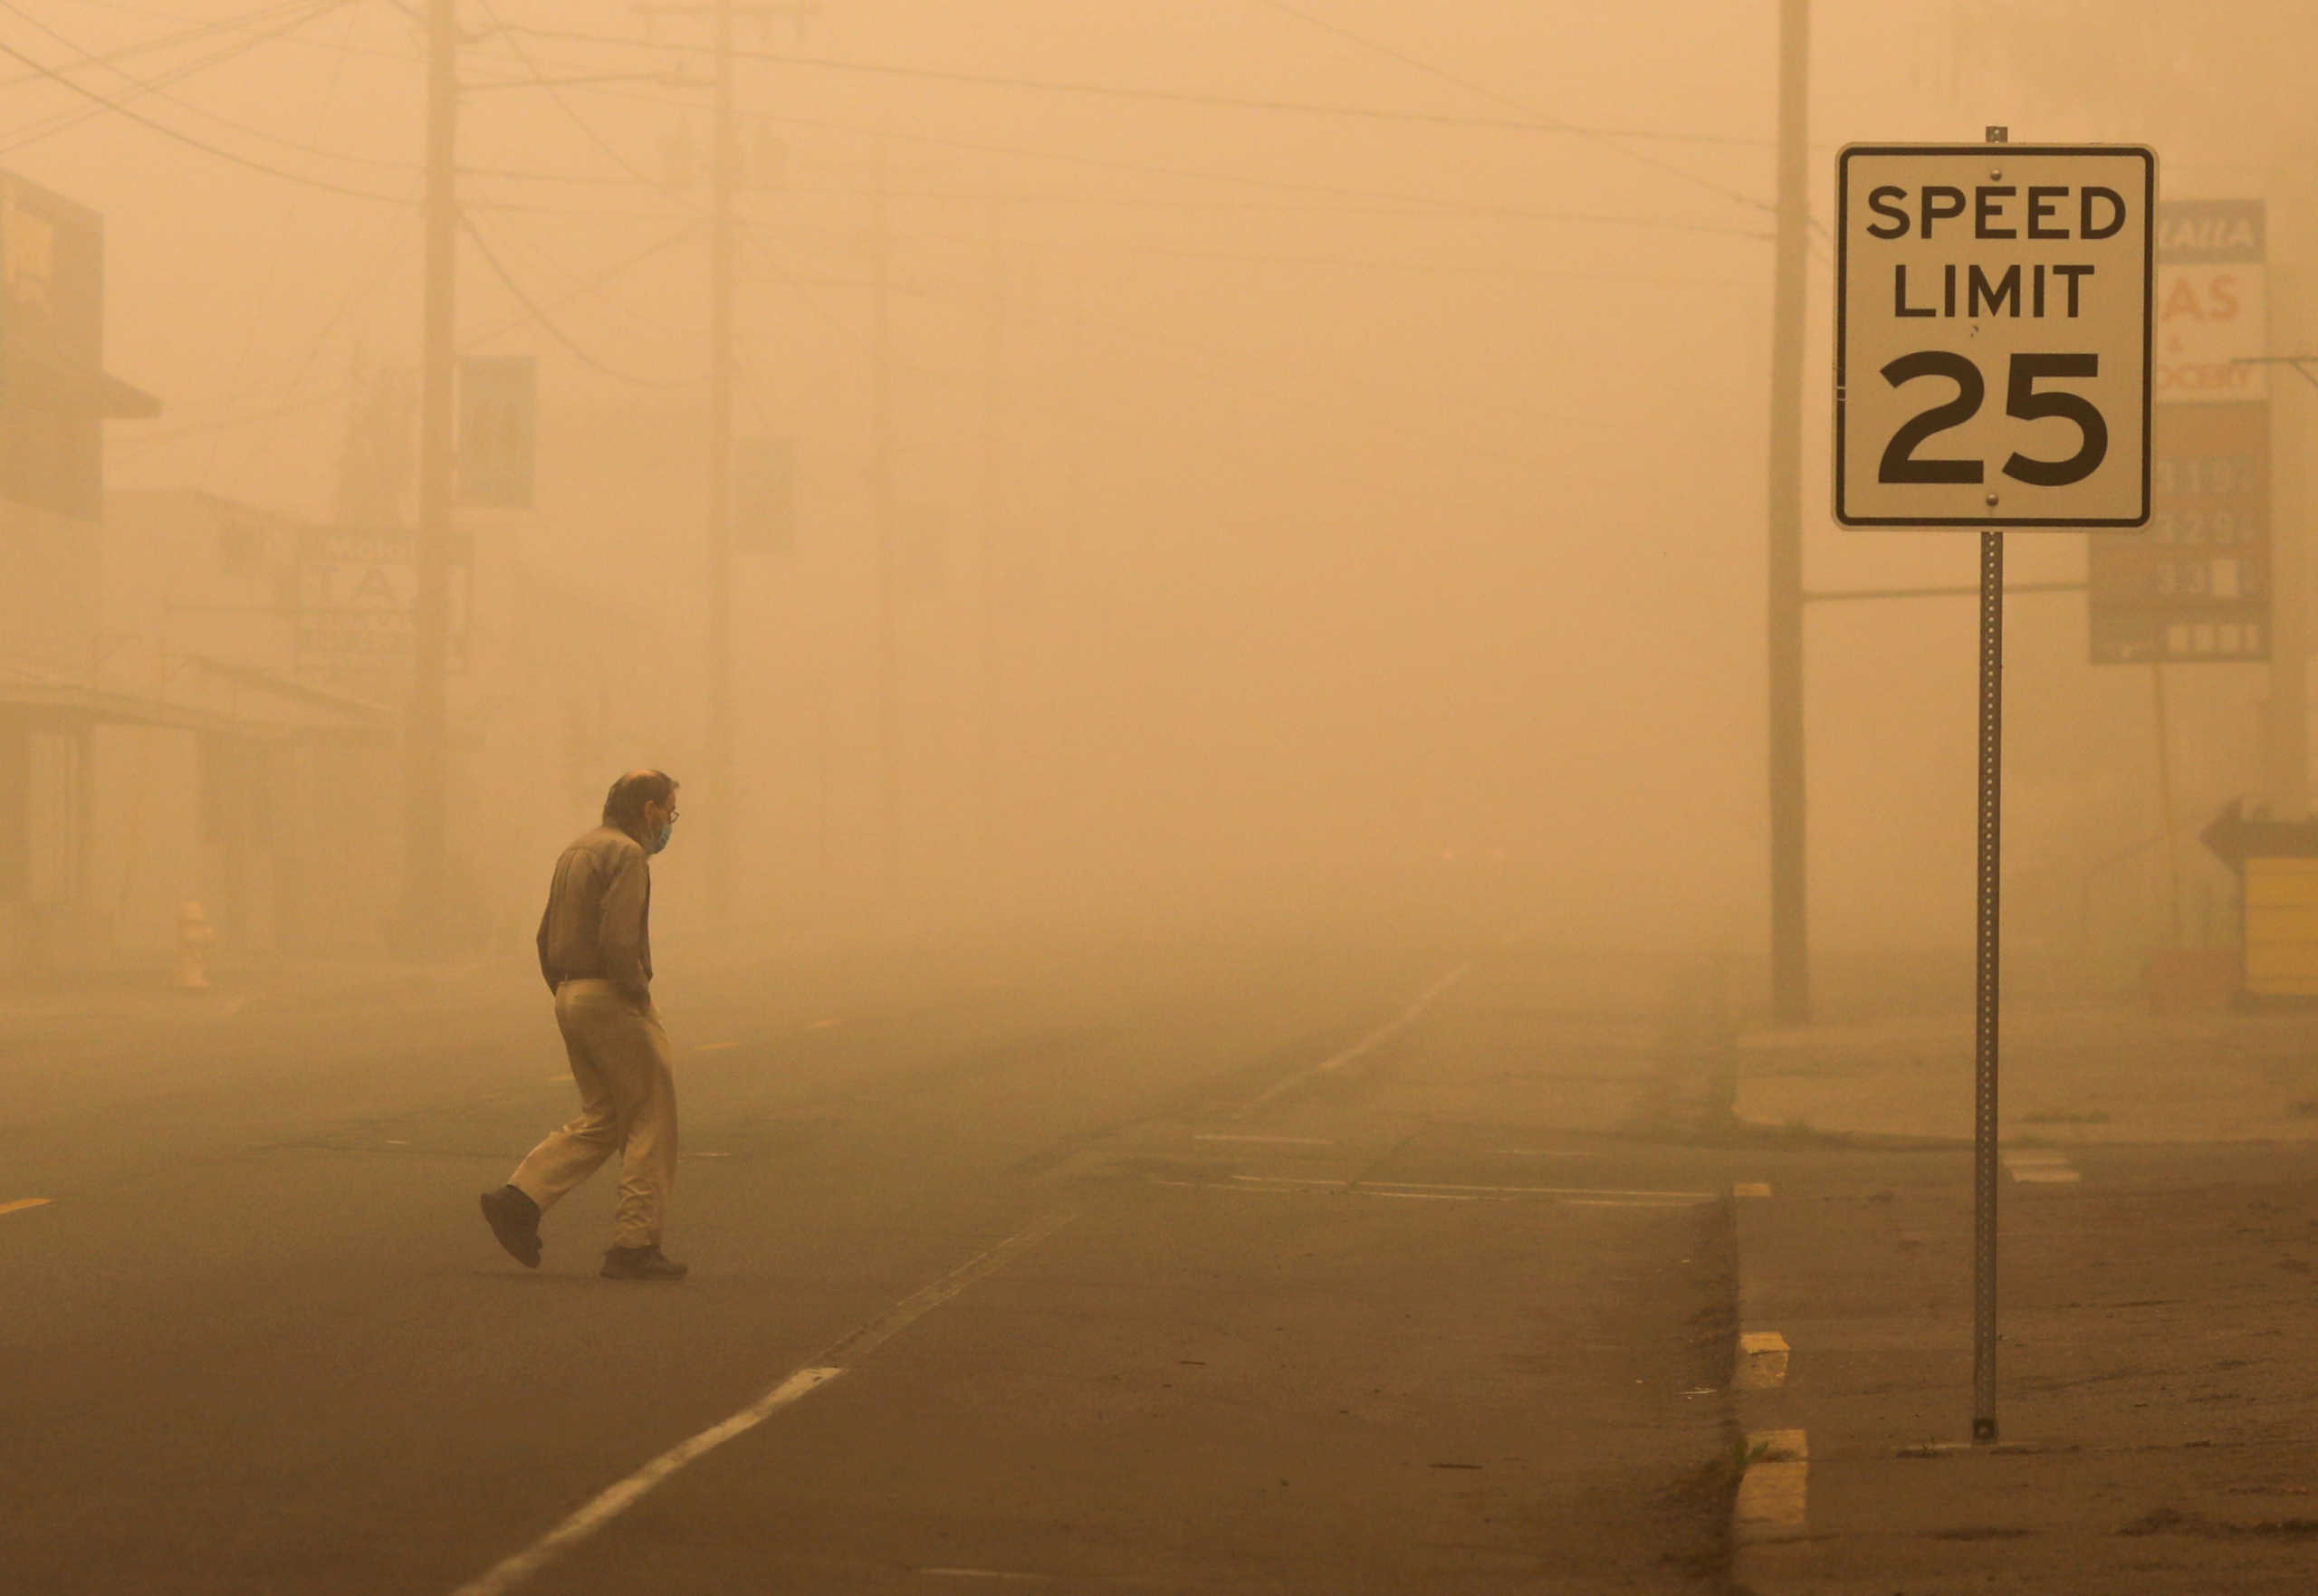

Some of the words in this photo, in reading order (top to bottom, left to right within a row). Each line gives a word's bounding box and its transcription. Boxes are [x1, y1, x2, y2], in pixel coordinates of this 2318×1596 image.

[1866, 186, 2126, 239] SPEED
[1895, 264, 2094, 318] LIMIT
[2161, 275, 2240, 321] AS
[2156, 364, 2251, 390] OCERY
[1879, 350, 2108, 486] 25
